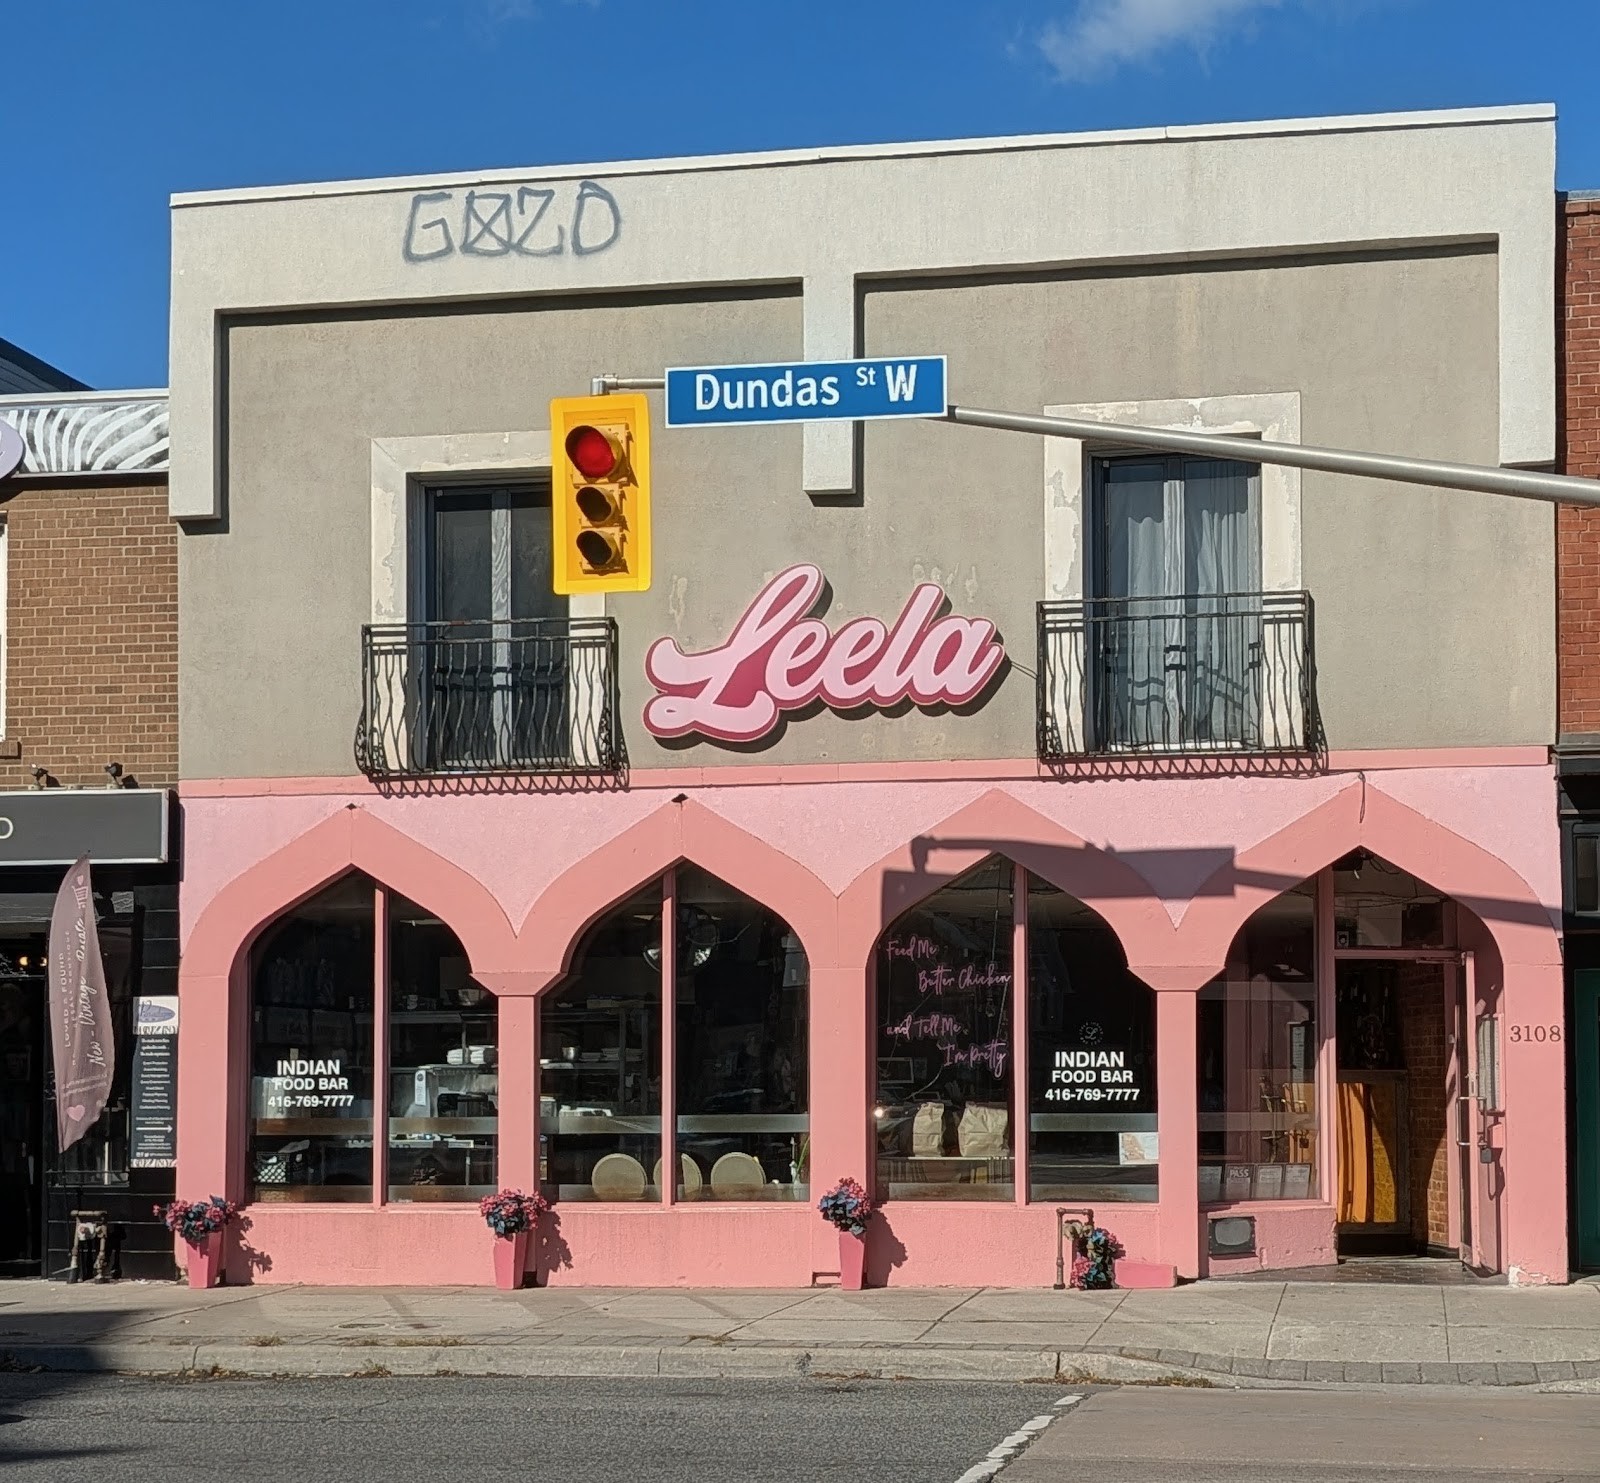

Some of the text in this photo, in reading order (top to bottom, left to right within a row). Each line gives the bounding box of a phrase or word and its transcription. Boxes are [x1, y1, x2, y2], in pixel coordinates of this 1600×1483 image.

[695, 364, 918, 411] Dundas St W
[643, 563, 1004, 741] Leela
[886, 935, 914, 961] Feed
[918, 963, 1011, 996] Butter Chicken
[77, 976, 98, 1026] Vintage
[1509, 1025, 1561, 1043] 3108
[86, 1042, 107, 1067] New
[1054, 1051, 1125, 1068] INDIAN
[277, 1059, 341, 1075] INDIAN
[274, 1077, 349, 1090] FOOD BAR
[1052, 1070, 1133, 1083] FOOD BAR
[267, 1095, 354, 1107] 416-769-7777
[1045, 1088, 1140, 1101] 416-769-7777
[1229, 1168, 1249, 1178] PASS
